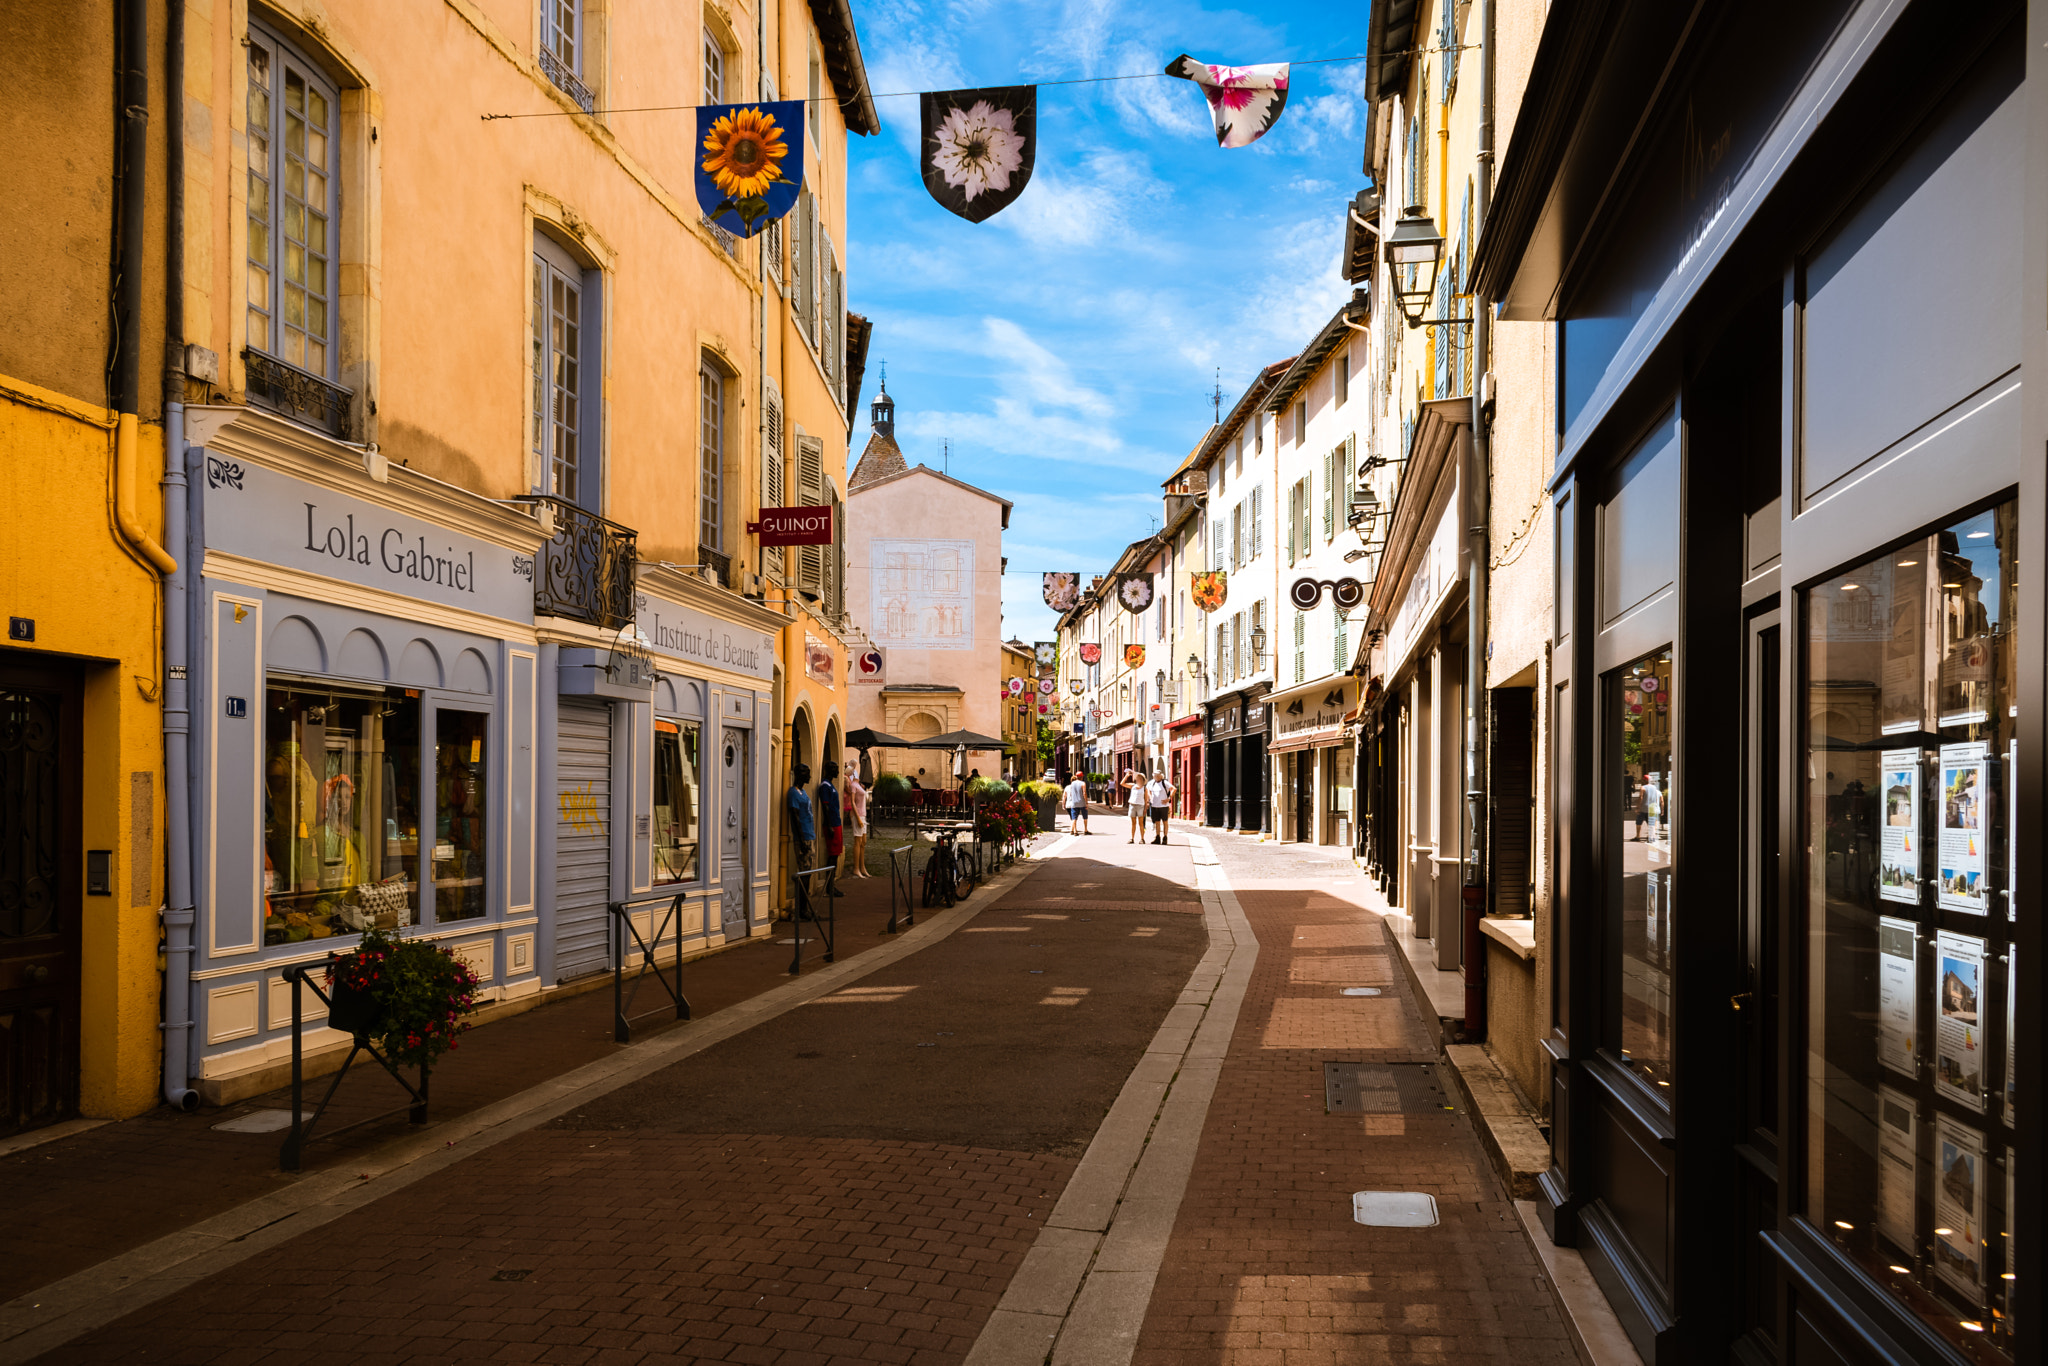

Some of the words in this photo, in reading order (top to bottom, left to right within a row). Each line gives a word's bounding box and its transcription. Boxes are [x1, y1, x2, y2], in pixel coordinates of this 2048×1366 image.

[762, 516, 828, 532] GUINOT
[304, 502, 371, 566] Lola
[380, 527, 475, 593] Gabriel
[19, 621, 28, 637] 9
[653, 612, 702, 655] Institut
[704, 628, 719, 661] de
[722, 636, 760, 671] Beauté
[228, 699, 237, 715] 11
